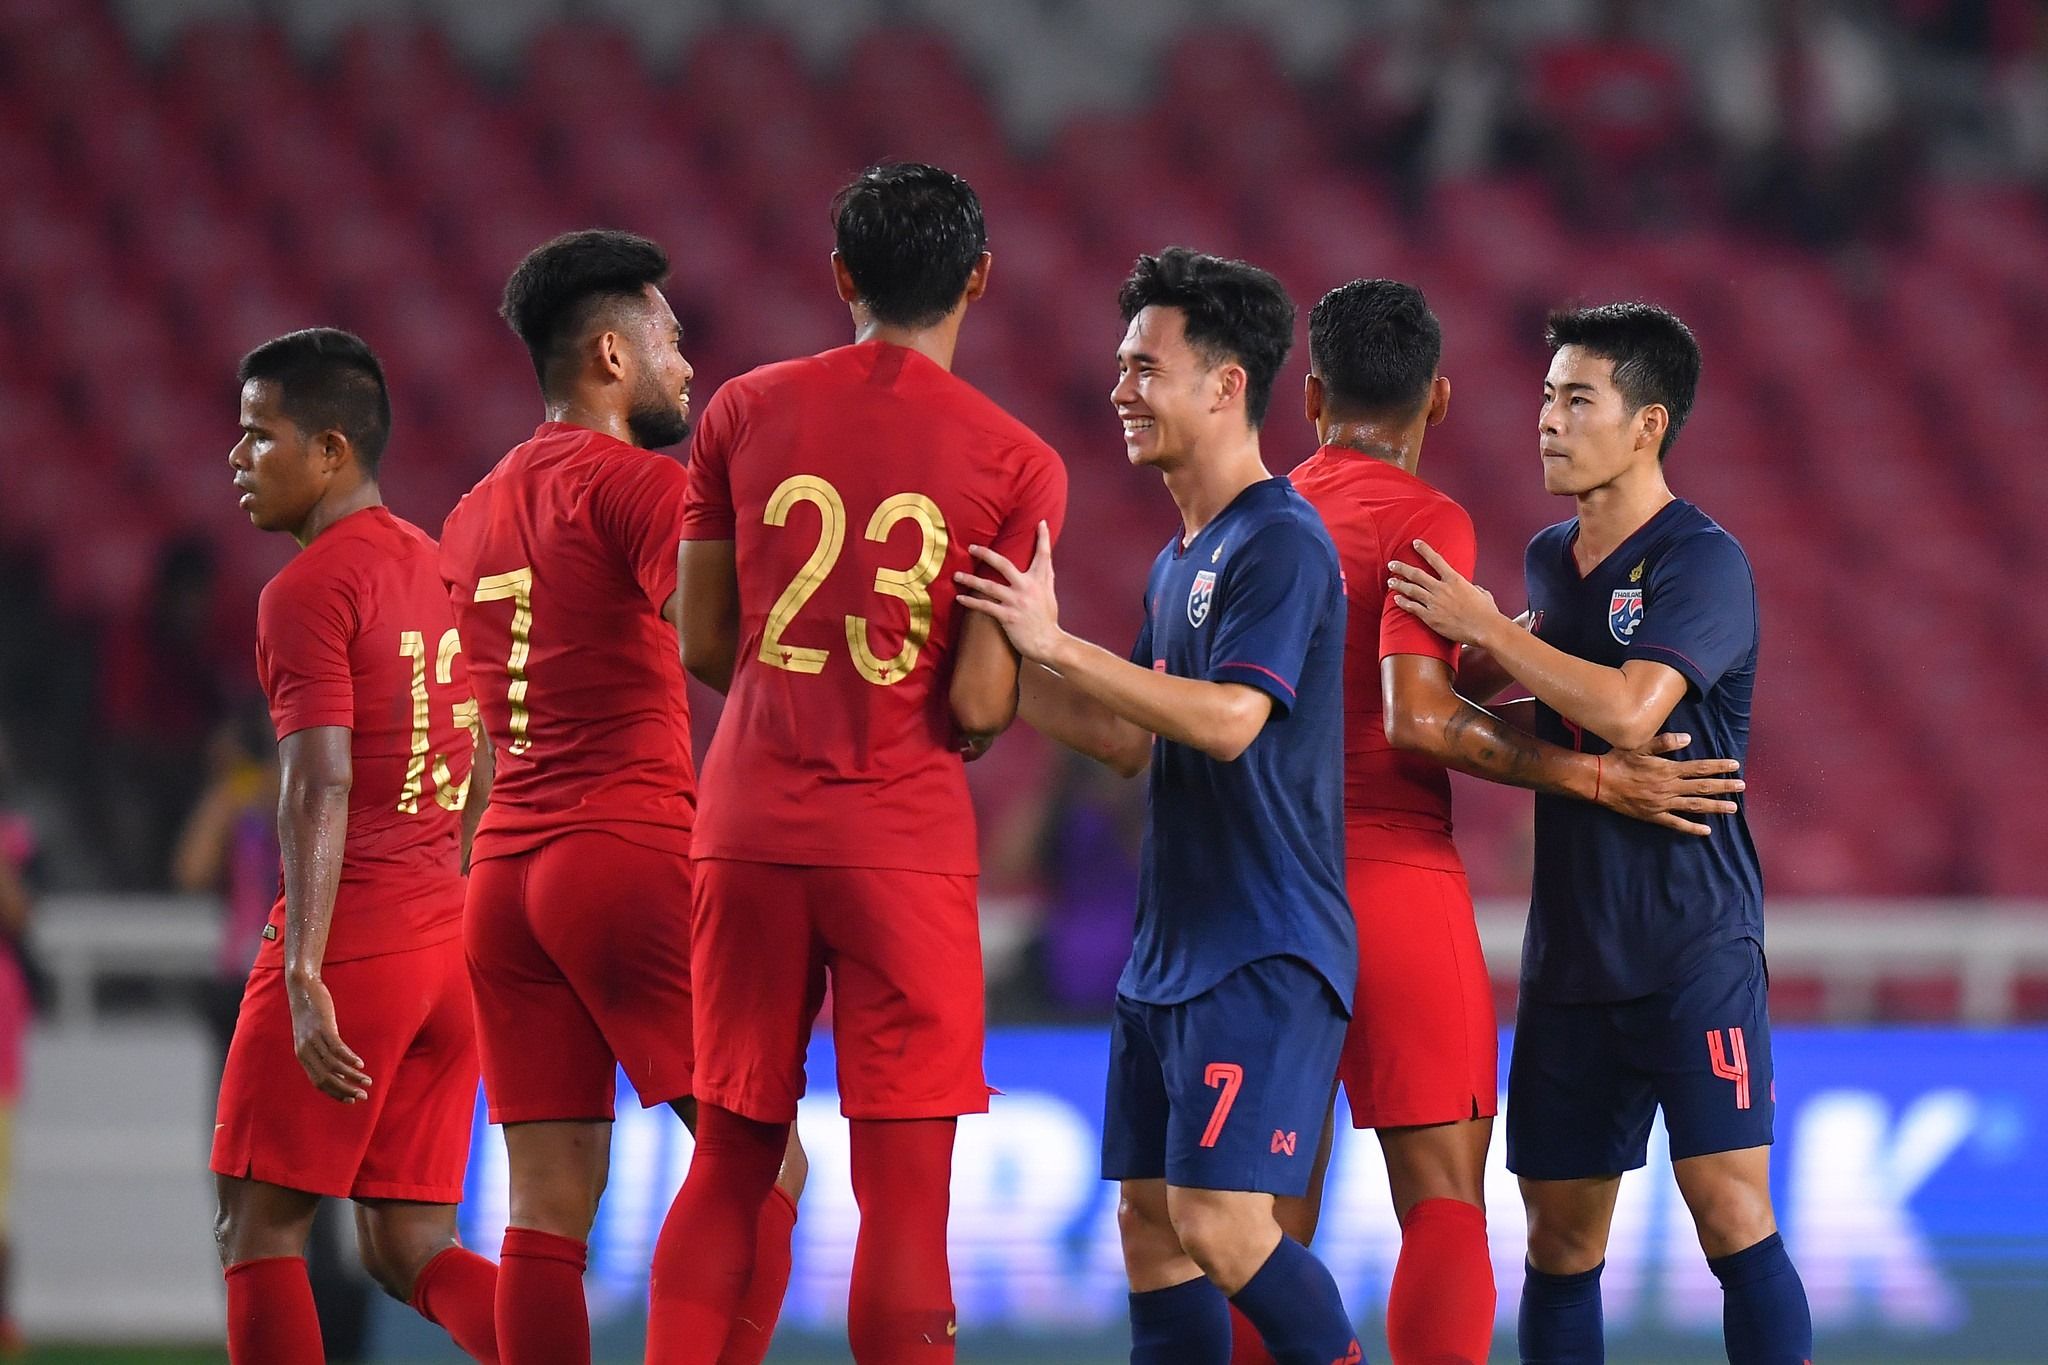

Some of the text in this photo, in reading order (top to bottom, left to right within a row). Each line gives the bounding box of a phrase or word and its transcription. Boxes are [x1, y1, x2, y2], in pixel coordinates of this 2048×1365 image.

[474, 566, 532, 755] 7
[757, 474, 948, 686] 23
[397, 628, 479, 814] 13
[1200, 1062, 1243, 1148] 7
[1706, 1027, 1750, 1109] 4
